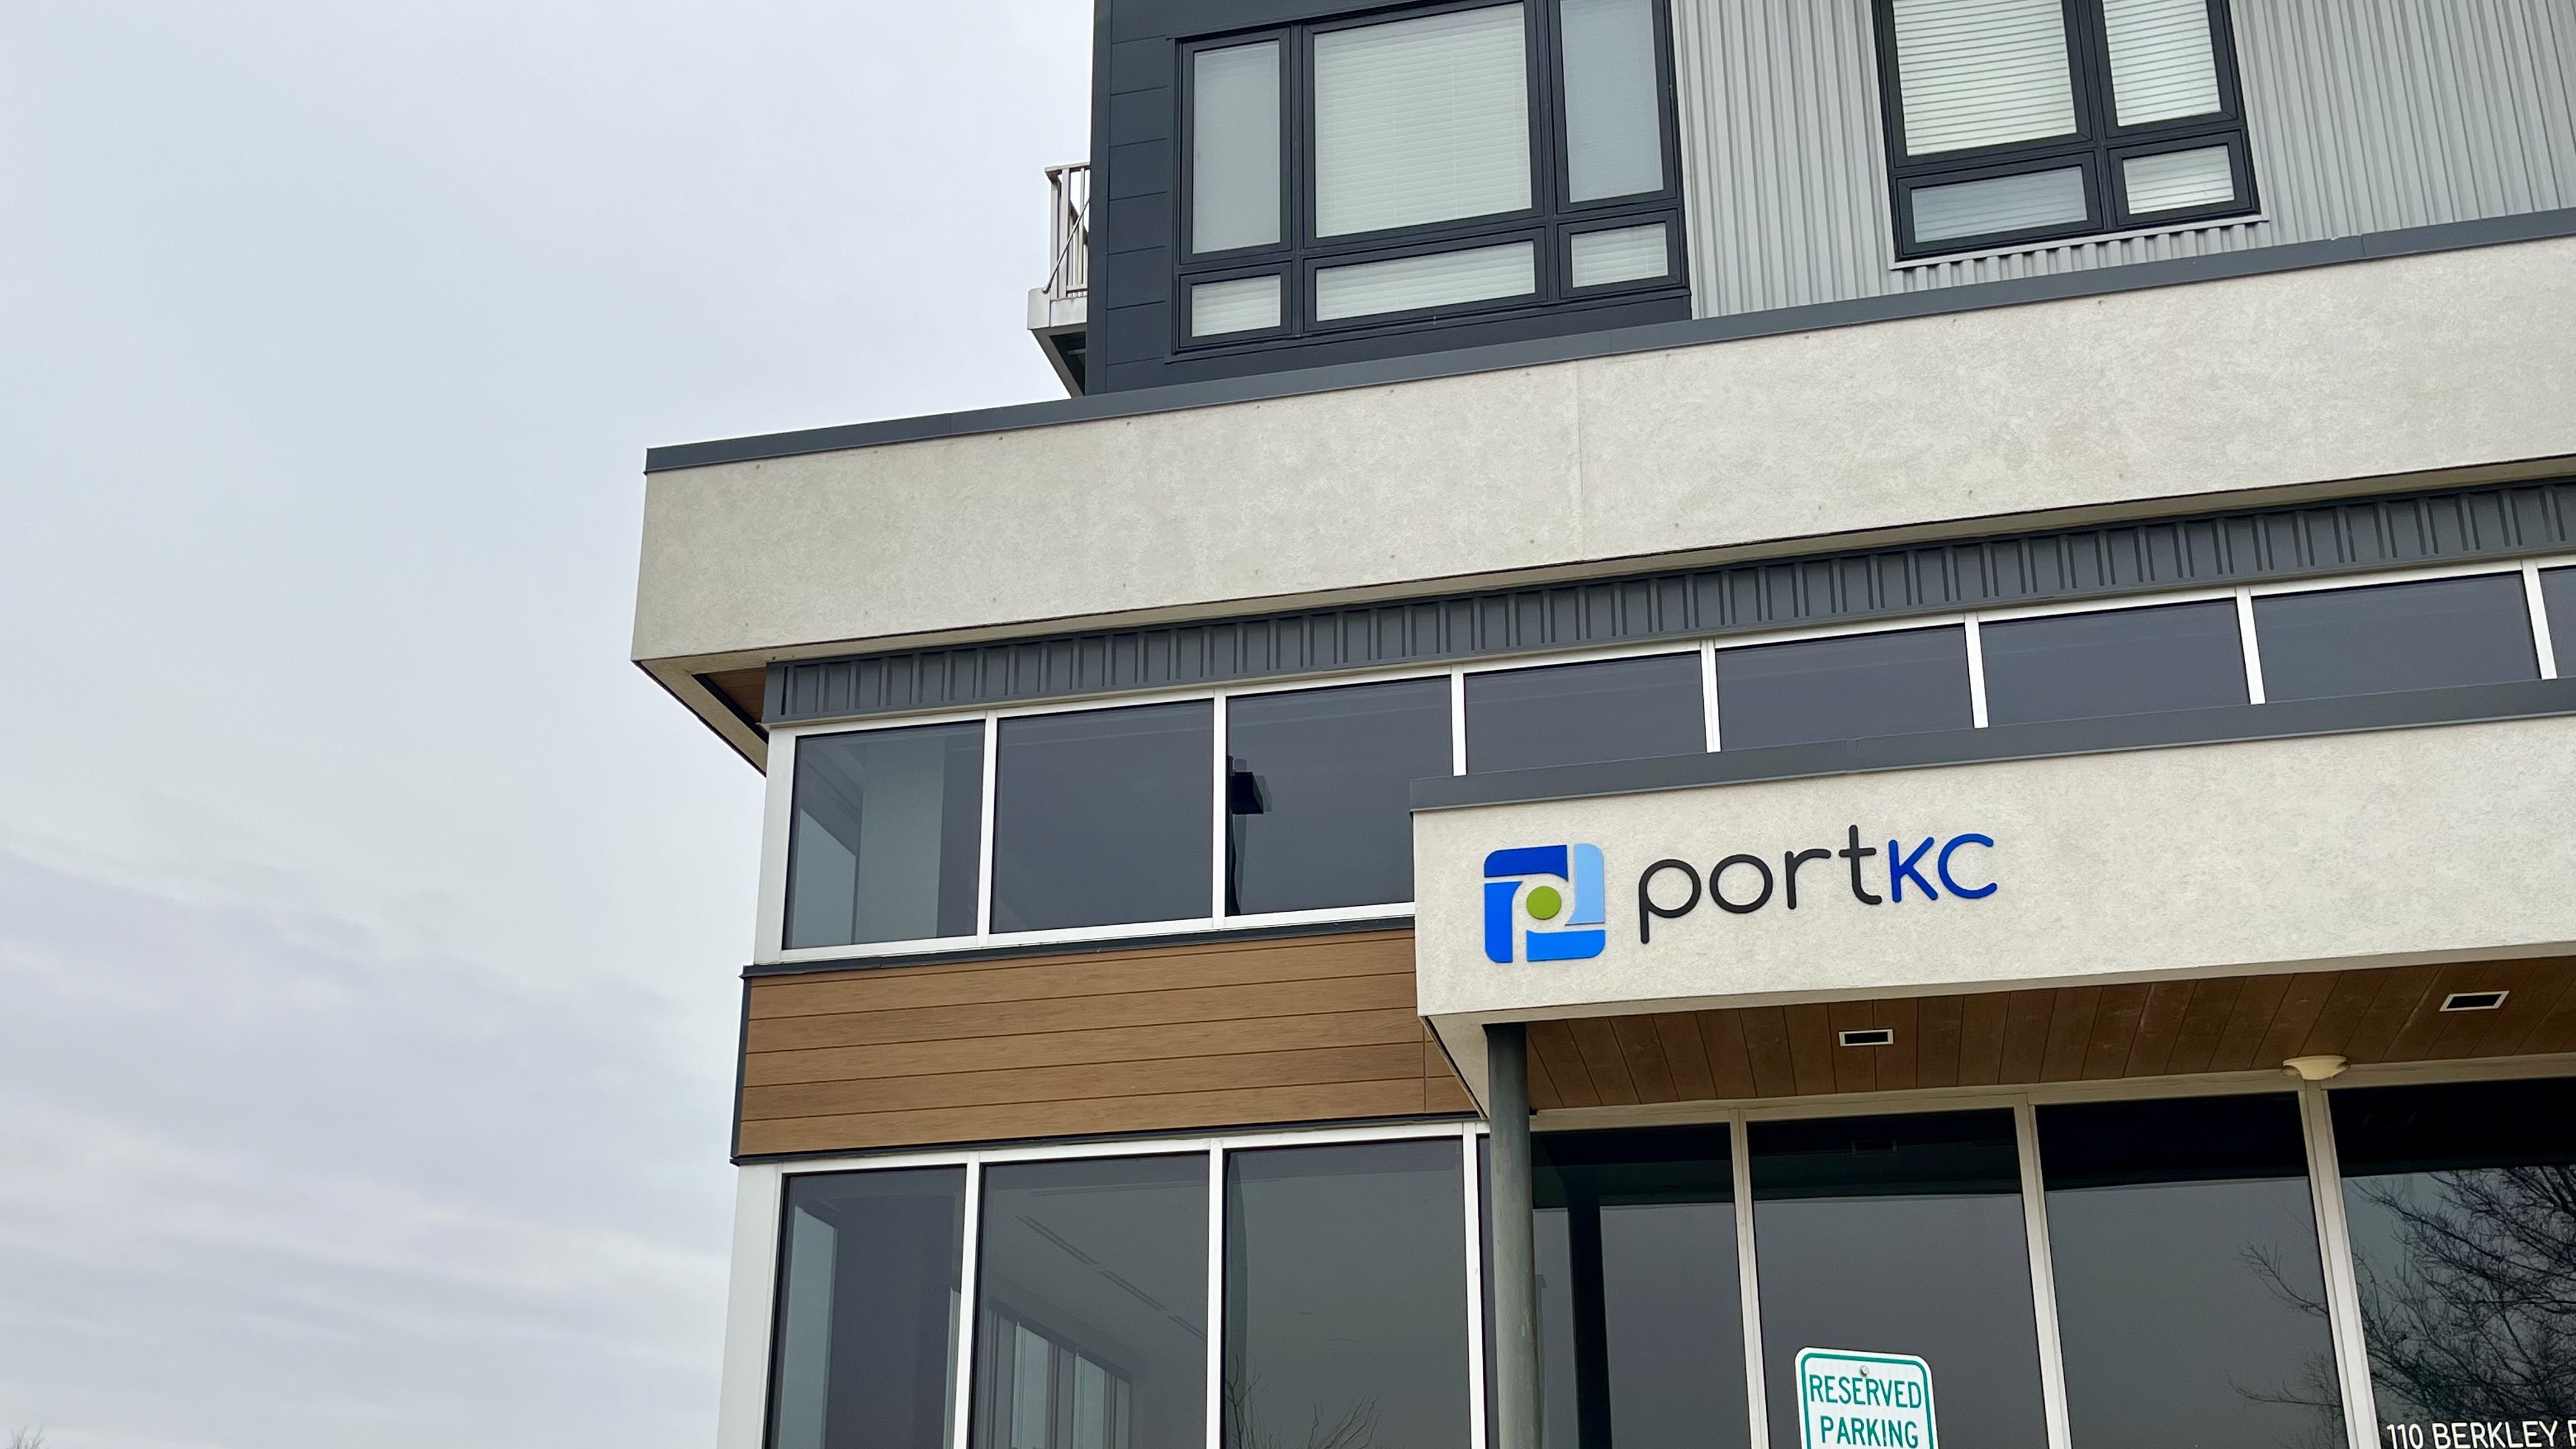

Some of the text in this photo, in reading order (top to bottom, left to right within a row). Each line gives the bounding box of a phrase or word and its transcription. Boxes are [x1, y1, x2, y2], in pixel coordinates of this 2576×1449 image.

[1809, 1374, 1922, 1409] RESERVED
[1820, 1415, 1919, 1448] PARKING
[2386, 1423, 2423, 1449] 110
[2432, 1420, 2558, 1449] BERKLEY
